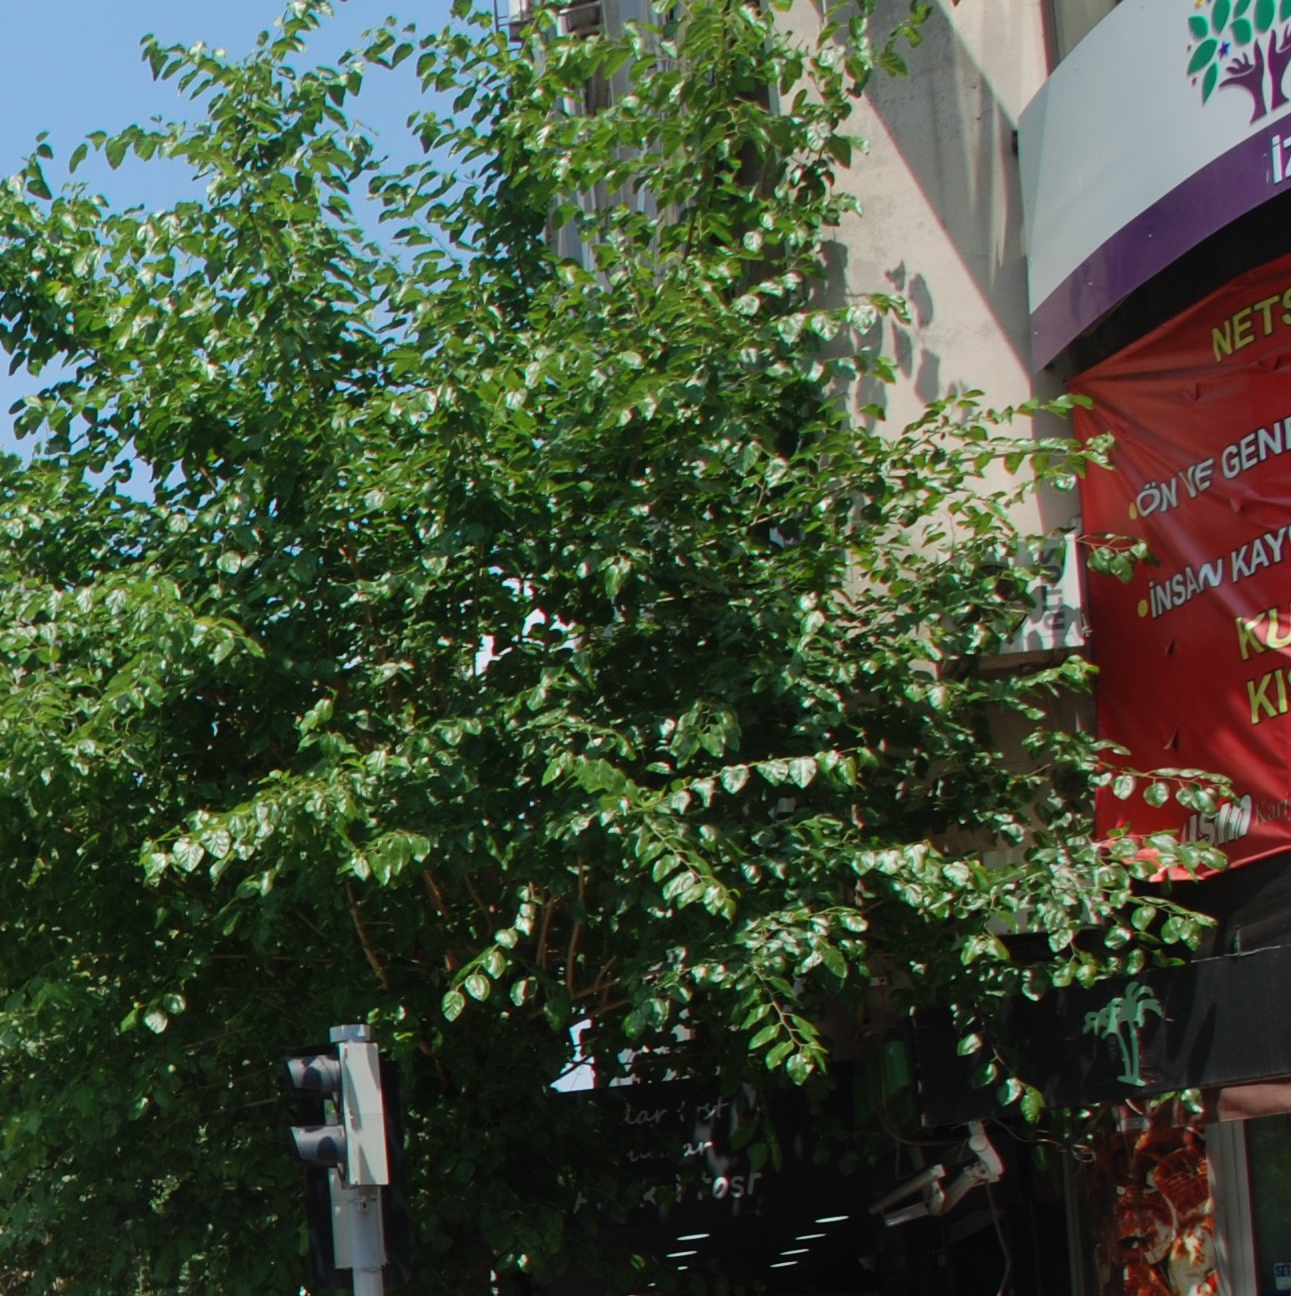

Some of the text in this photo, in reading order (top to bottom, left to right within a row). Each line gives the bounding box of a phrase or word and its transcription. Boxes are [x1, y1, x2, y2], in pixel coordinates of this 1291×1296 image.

[1135, 476, 1178, 517] ÖN
[1179, 457, 1215, 498] VE
[1149, 523, 1291, 620] İNSAN KAY
[1246, 668, 1291, 725] KI
